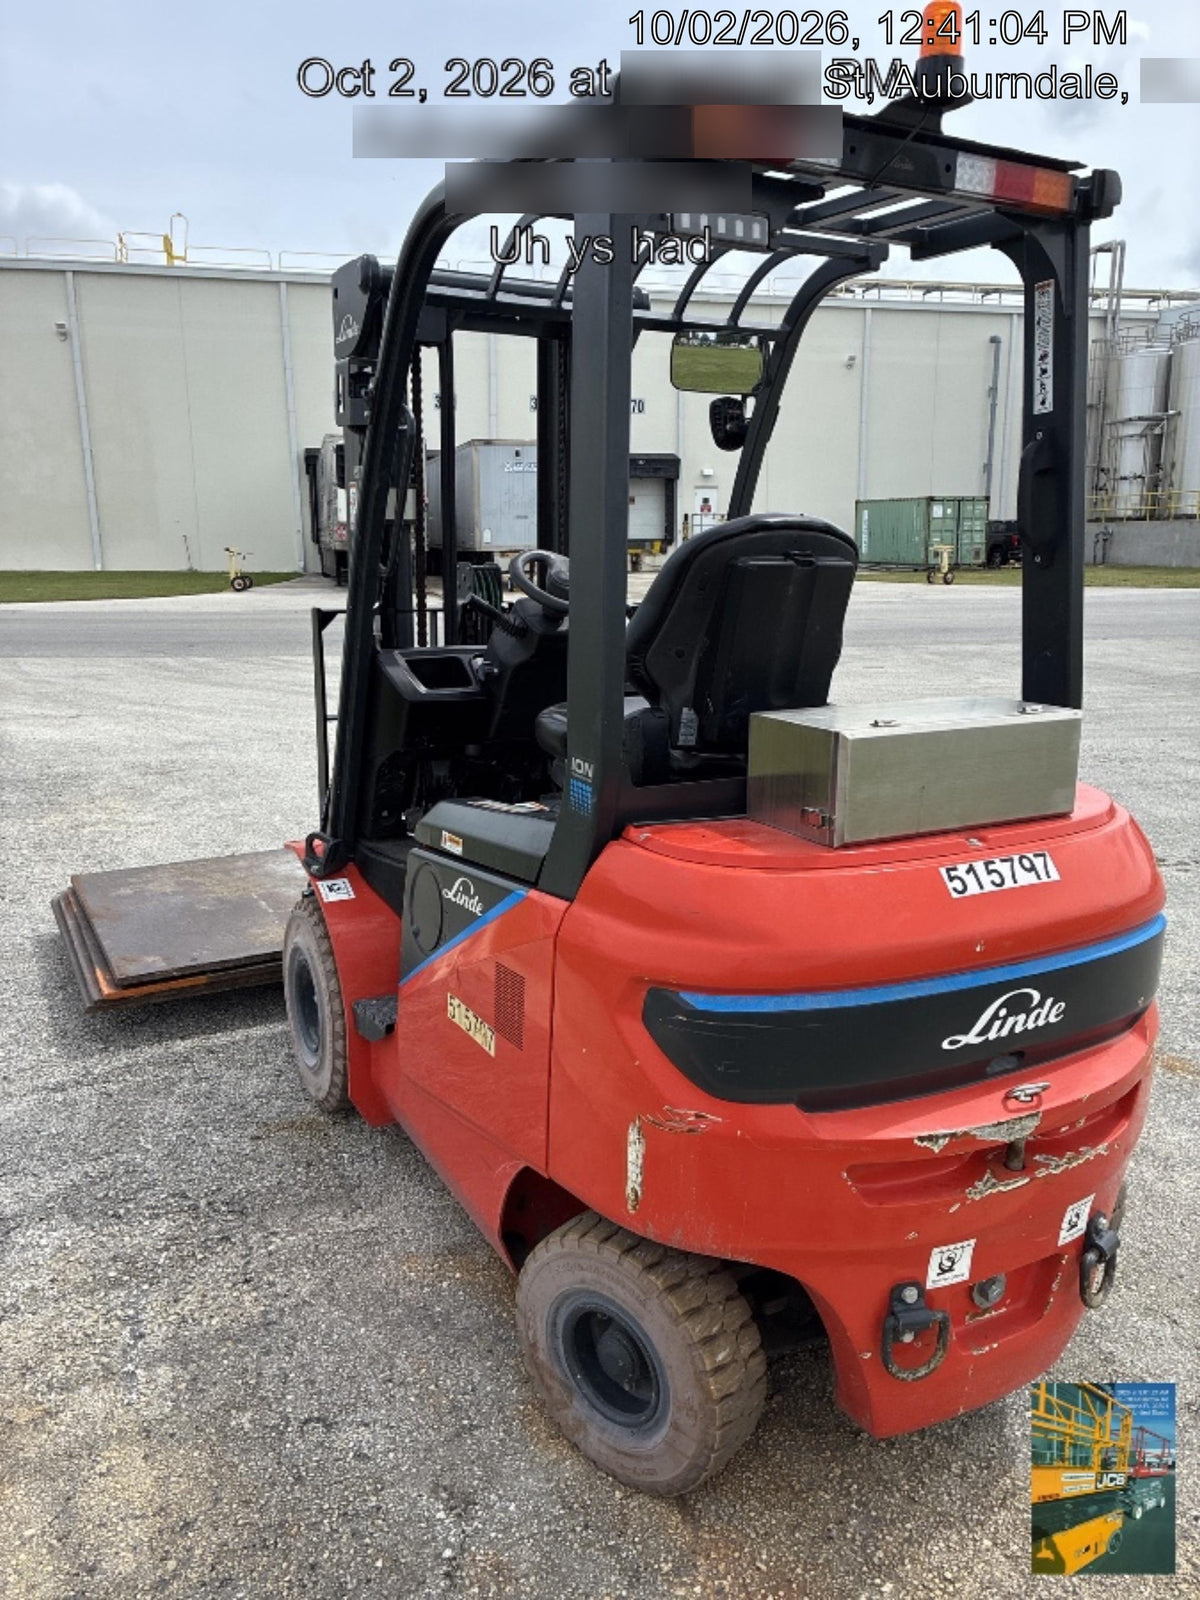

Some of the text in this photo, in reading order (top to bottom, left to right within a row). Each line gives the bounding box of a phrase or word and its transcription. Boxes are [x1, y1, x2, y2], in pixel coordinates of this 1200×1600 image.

[631, 400, 645, 414] 70
[571, 757, 595, 778] ION
[945, 852, 1053, 895] 515797
[442, 877, 484, 916] Linde
[941, 987, 1066, 1050] Linde
